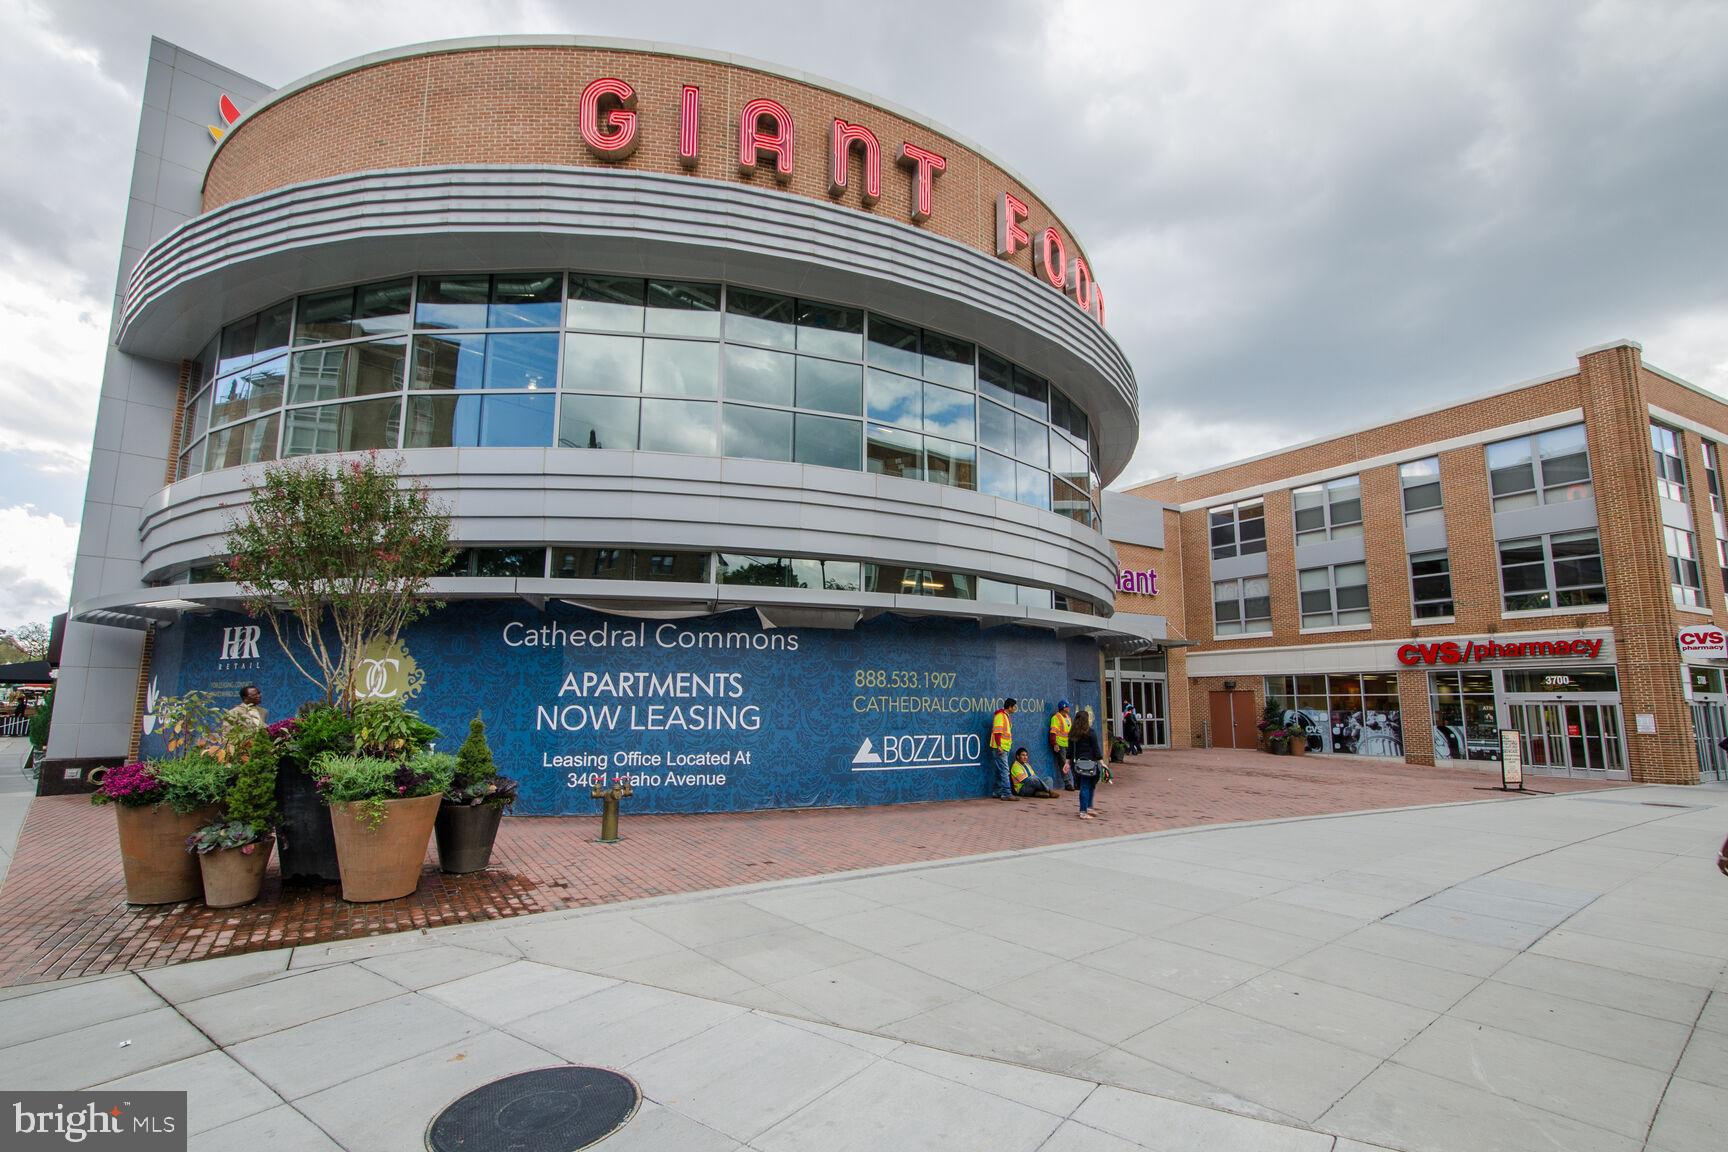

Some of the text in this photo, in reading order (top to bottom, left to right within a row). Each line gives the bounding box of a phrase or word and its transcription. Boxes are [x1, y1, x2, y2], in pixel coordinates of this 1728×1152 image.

[1116, 560, 1159, 595] iant
[502, 620, 799, 651] Cathedral Commons
[1680, 631, 1724, 645] CVS
[1397, 638, 1603, 666] CVS/pharmacy
[218, 661, 261, 670] RETAIL
[557, 671, 744, 698] APARTMENTS
[855, 670, 957, 689] 888.533.1907
[1545, 675, 1570, 685] 3700
[853, 696, 1045, 713] CATHEDRALCOMMOS.COM
[536, 705, 761, 731] NOW LEASING
[1305, 725, 1323, 733] CVS
[883, 734, 981, 763] BOZZUTO
[543, 750, 751, 770] Leasing Office Located At
[567, 772, 608, 788] 3401
[664, 771, 726, 786] Avenue
